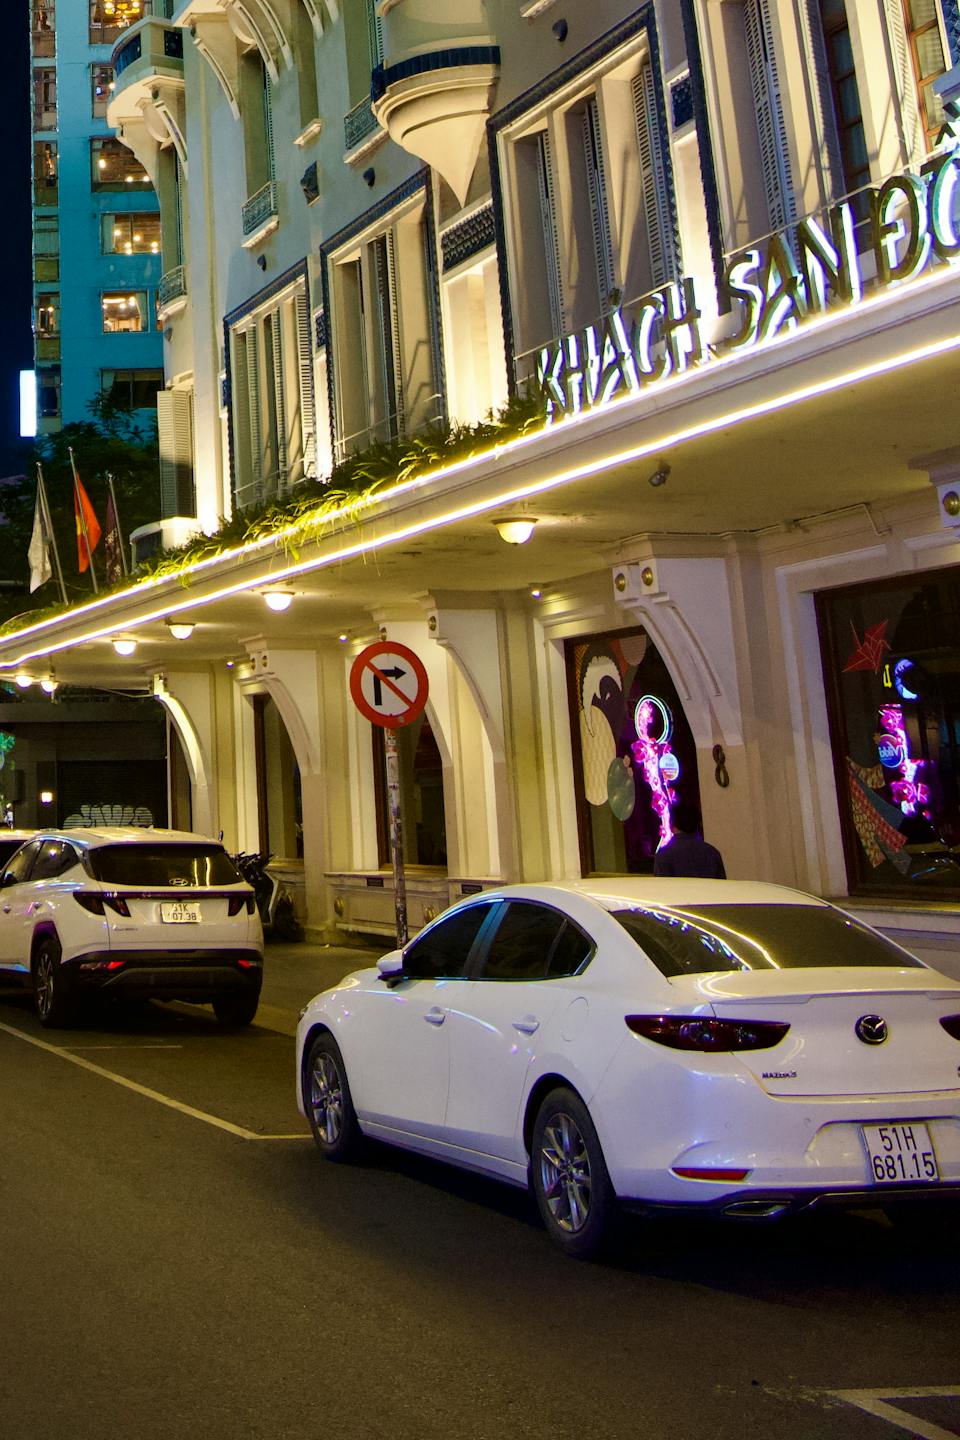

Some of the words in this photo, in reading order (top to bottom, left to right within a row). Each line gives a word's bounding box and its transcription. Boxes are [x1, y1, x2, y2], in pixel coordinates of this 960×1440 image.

[168, 912, 197, 921] 07.38
[878, 1126, 917, 1152] 51H
[872, 1152, 937, 1181] 681.15
